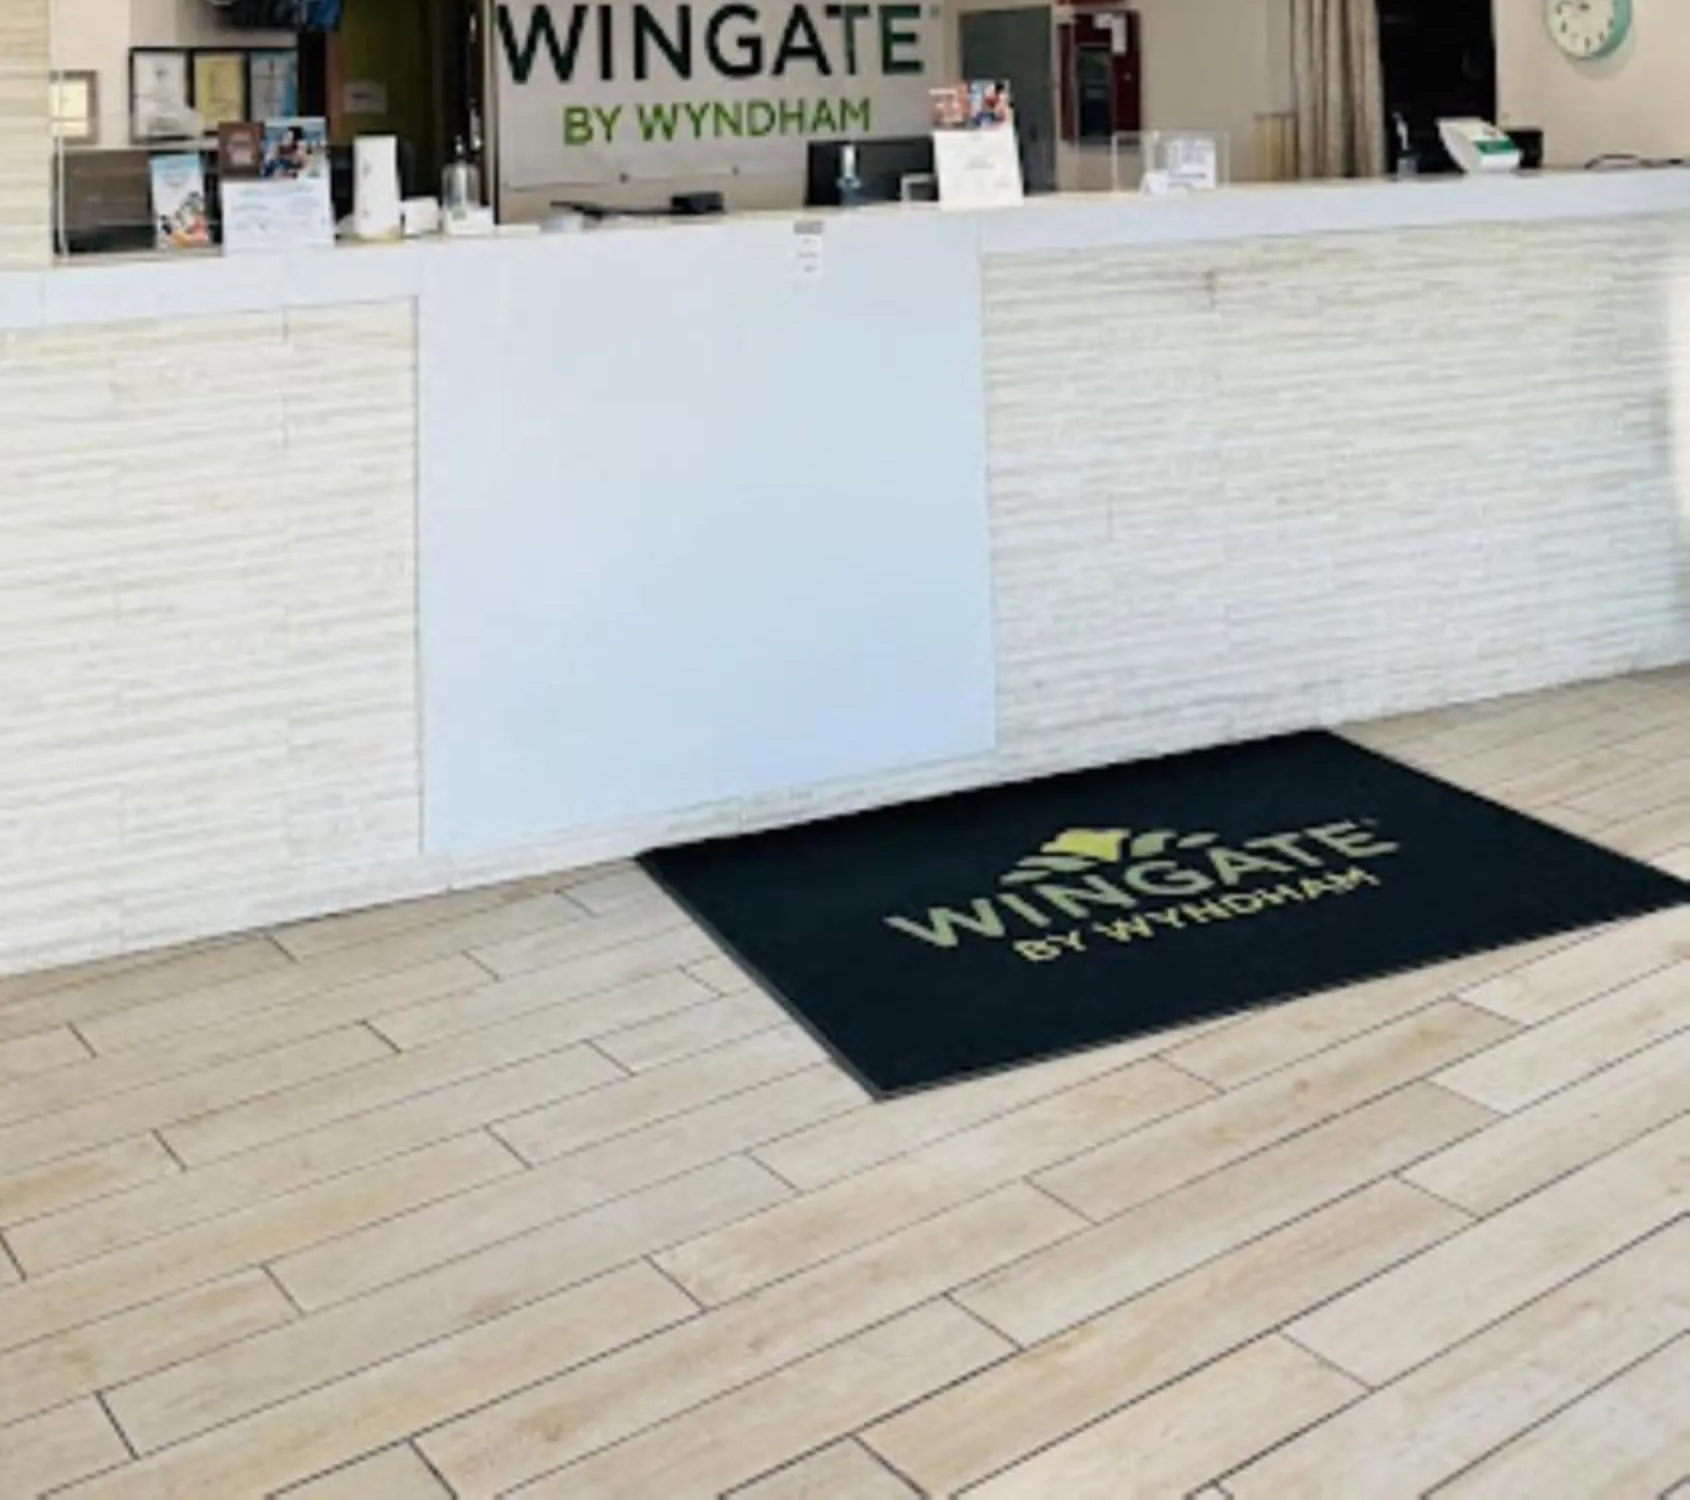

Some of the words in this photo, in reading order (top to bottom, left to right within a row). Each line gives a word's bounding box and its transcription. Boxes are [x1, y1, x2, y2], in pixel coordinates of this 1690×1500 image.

[495, 2, 926, 85] WINGATE
[562, 106, 622, 146] BY
[637, 98, 871, 141] WYNDHAM
[884, 819, 1398, 947] WINGATE
[1012, 928, 1087, 962] BY
[1092, 866, 1380, 942] WYNDHAM
